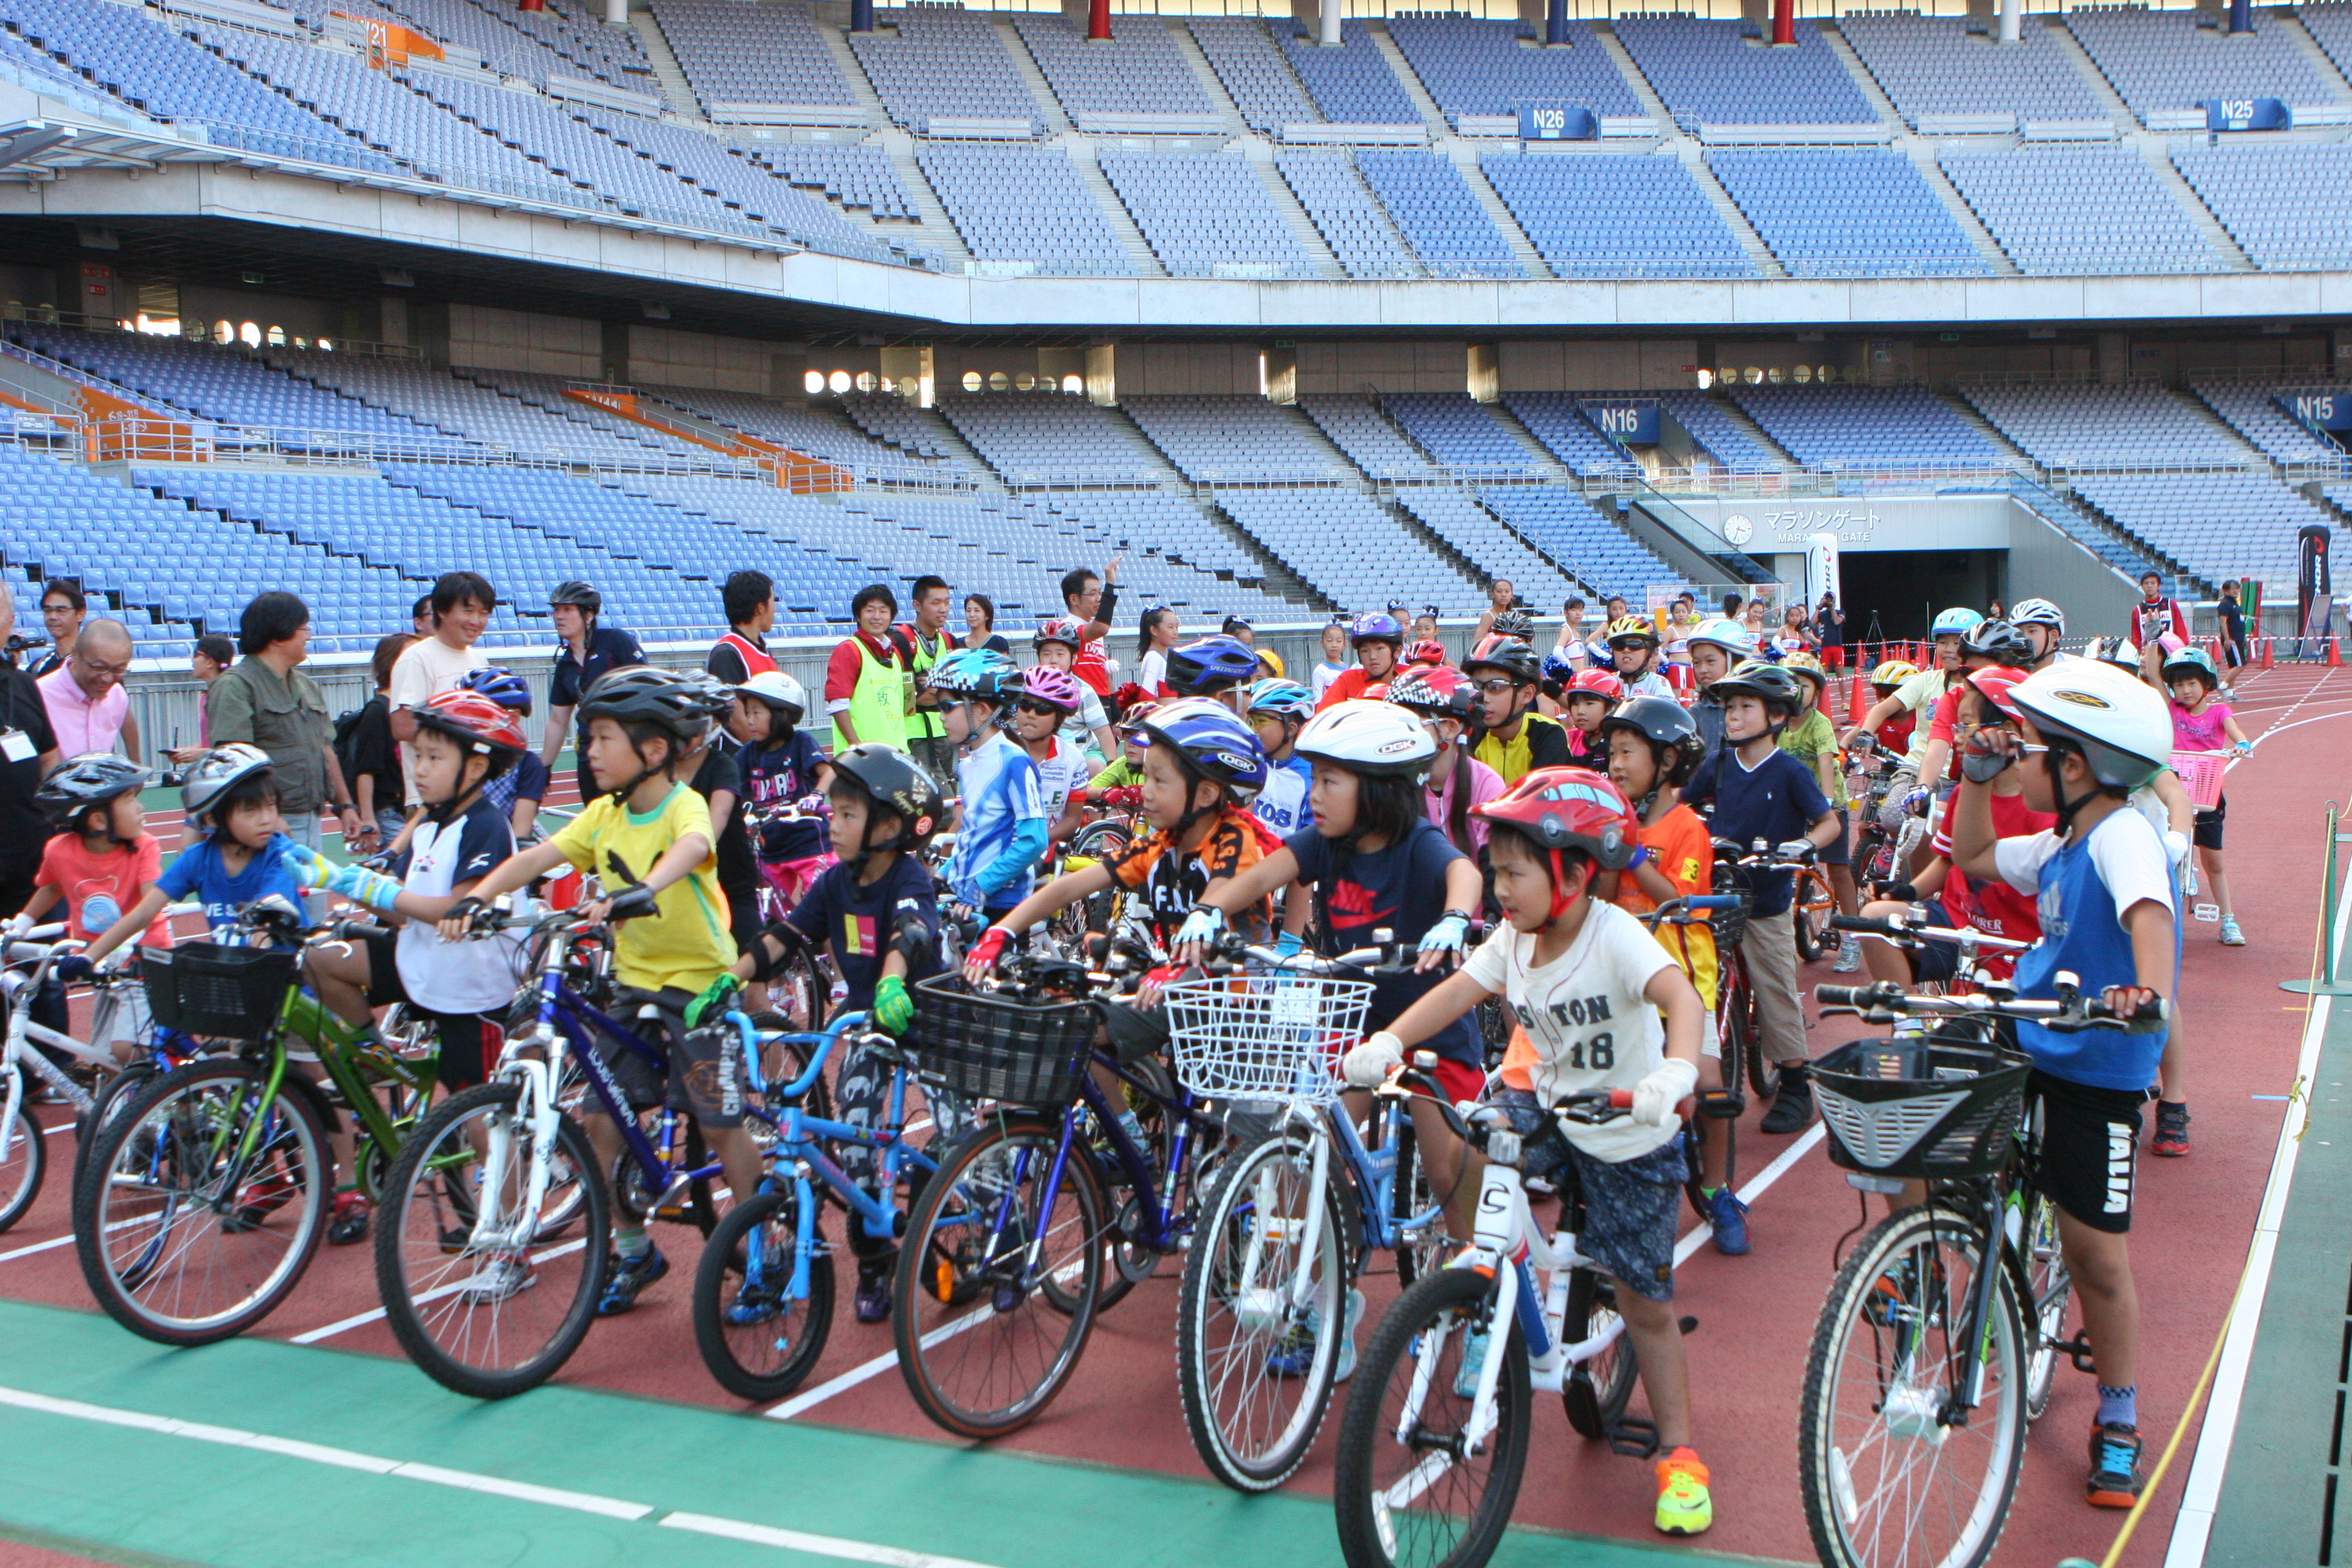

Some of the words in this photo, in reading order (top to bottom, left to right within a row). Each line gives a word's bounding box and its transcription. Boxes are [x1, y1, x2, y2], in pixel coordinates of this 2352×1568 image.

[1533, 109, 1565, 129] N26
[2221, 99, 2254, 119] N25
[2297, 396, 2334, 420] N15
[1601, 409, 1638, 432] N16
[1764, 508, 1881, 530] マラソンゲート
[1841, 532, 1871, 542] GATE
[2057, 690, 2106, 708] OGK
[1379, 739, 1414, 754] OGK
[1223, 754, 1253, 771] OGK
[897, 897, 919, 911] SOTA
[1570, 1032, 1614, 1070] 18
